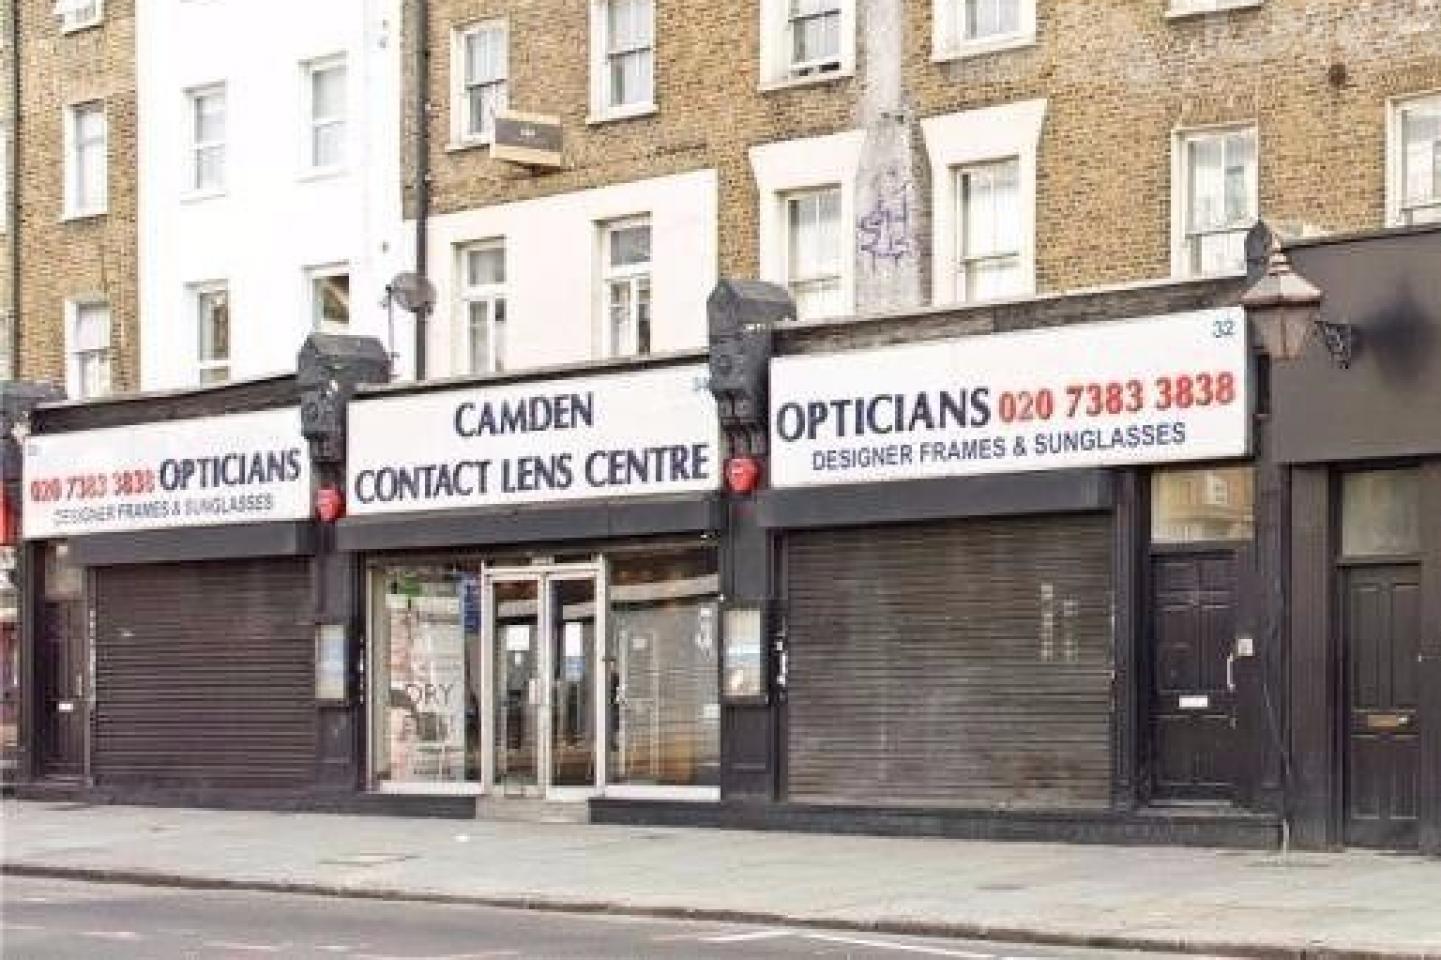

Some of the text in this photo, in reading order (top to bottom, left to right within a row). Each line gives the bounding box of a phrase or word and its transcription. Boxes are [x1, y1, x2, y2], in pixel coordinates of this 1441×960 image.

[455, 390, 595, 438] CAMDEN
[775, 371, 1236, 442] OPTICIANS 020 7383 3838
[159, 447, 302, 491] OPTICIANS
[812, 422, 1187, 471] DESIGNER FRAMES & SUNGLASSES
[354, 443, 710, 505] CONTACT LENS CENTRE
[117, 499, 170, 520] FRAMES
[184, 492, 274, 517] SUNGLASSES
